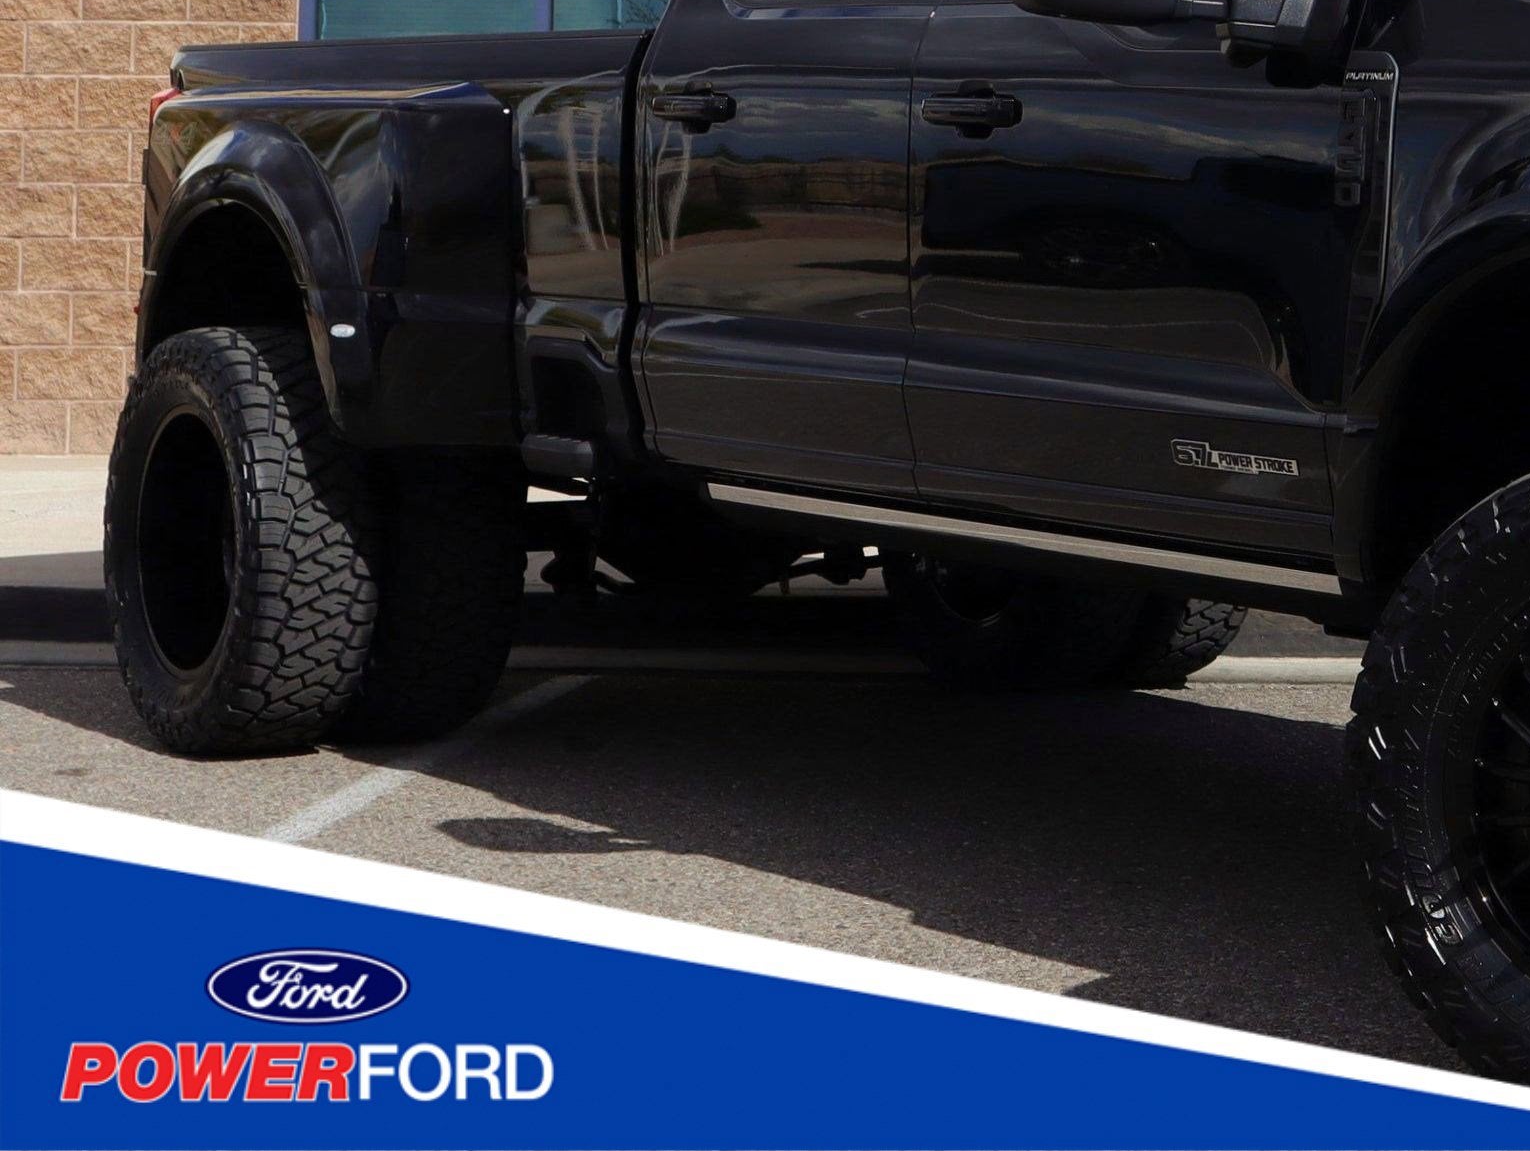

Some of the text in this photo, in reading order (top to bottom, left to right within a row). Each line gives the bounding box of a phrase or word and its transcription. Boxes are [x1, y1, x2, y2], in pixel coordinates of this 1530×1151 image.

[1345, 71, 1394, 81] PLATINUM
[1217, 452, 1253, 469] POWER
[1253, 456, 1295, 474] STROKE
